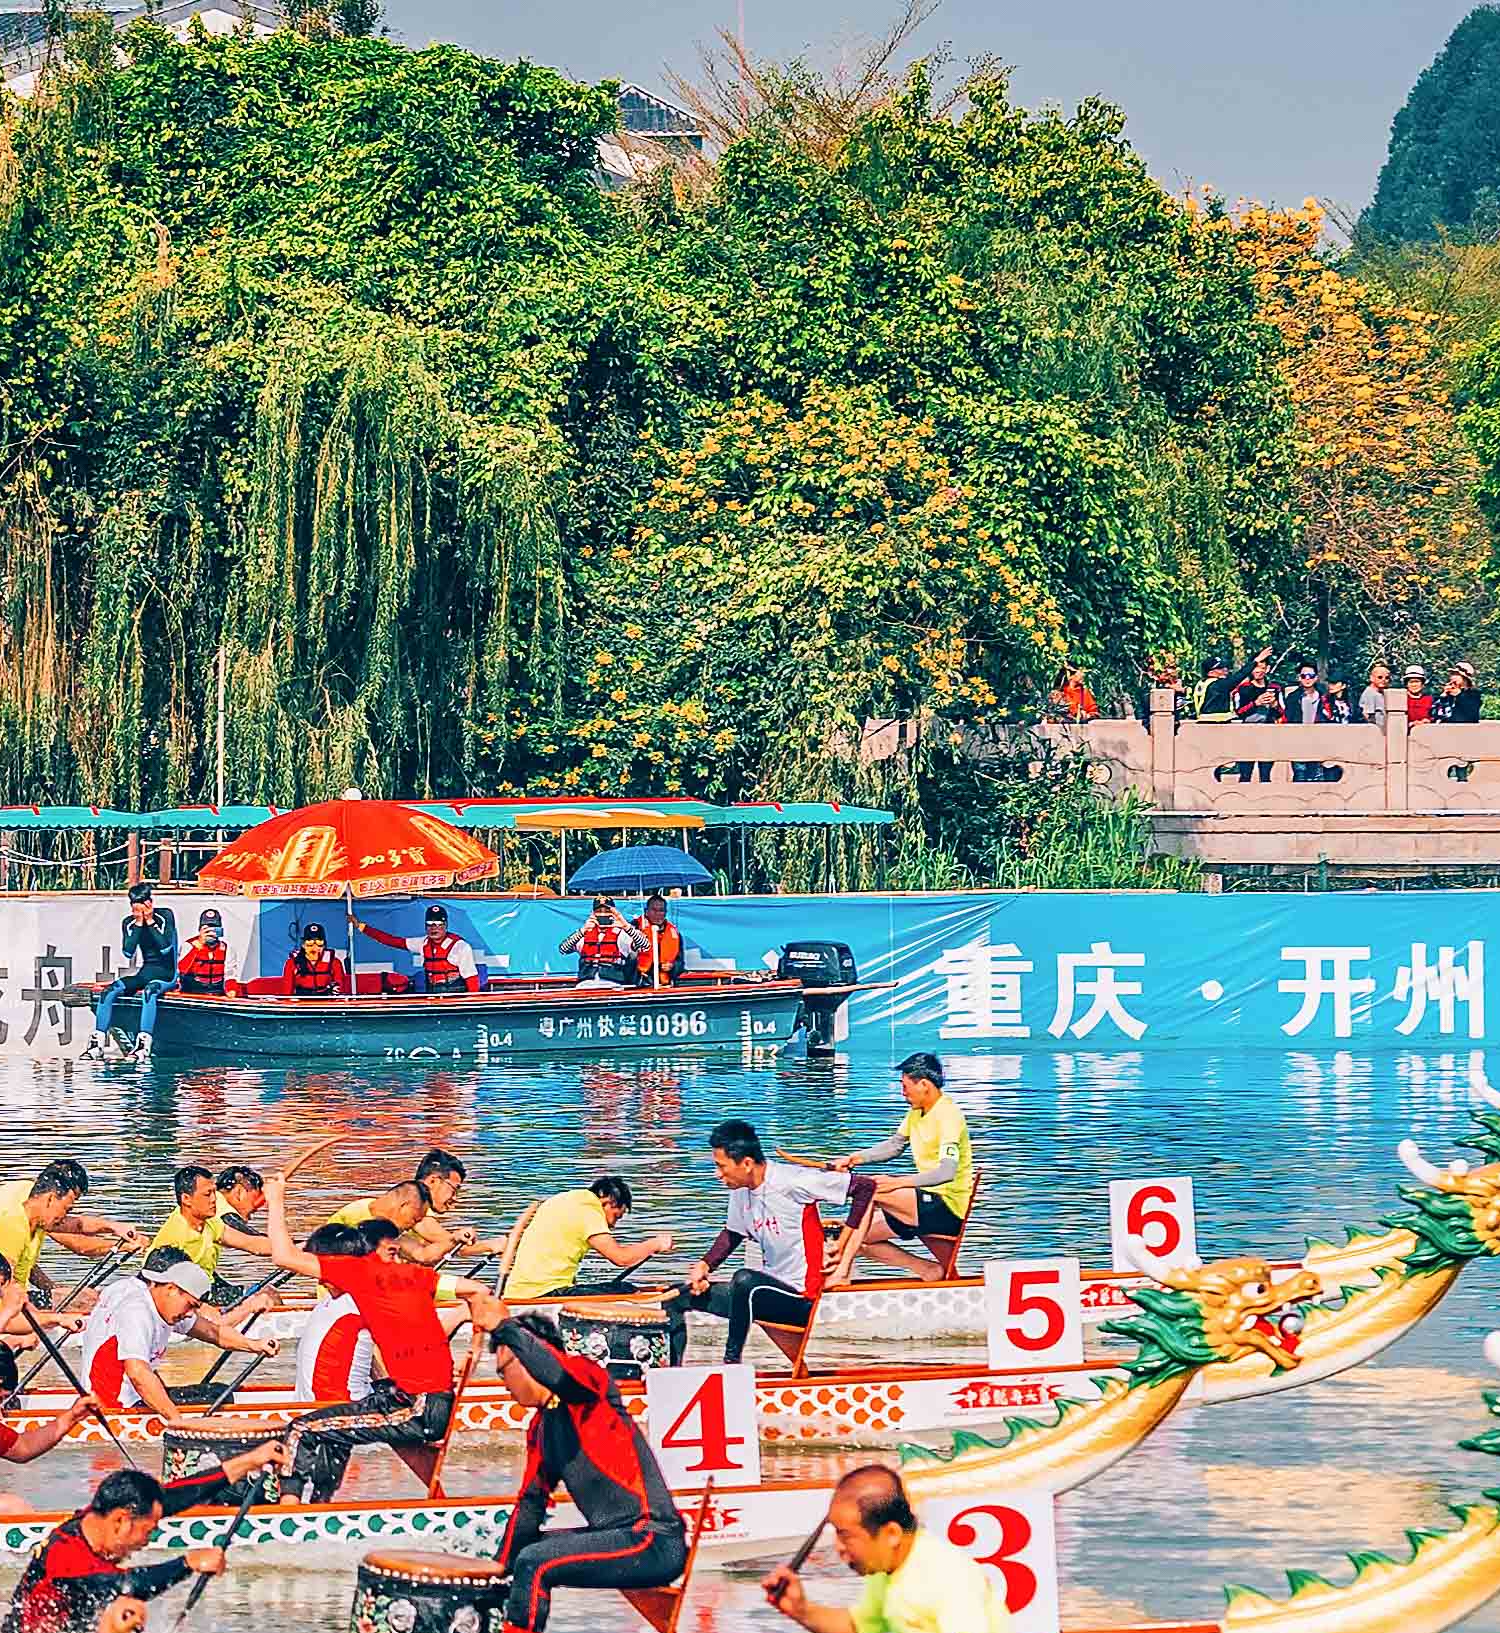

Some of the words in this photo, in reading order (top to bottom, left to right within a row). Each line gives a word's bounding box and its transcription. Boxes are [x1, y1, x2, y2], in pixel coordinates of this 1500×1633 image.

[1126, 1185, 1182, 1257] 6
[1006, 1270, 1066, 1351] 5
[661, 1373, 744, 1472] 4
[947, 1505, 1037, 1615] 3
